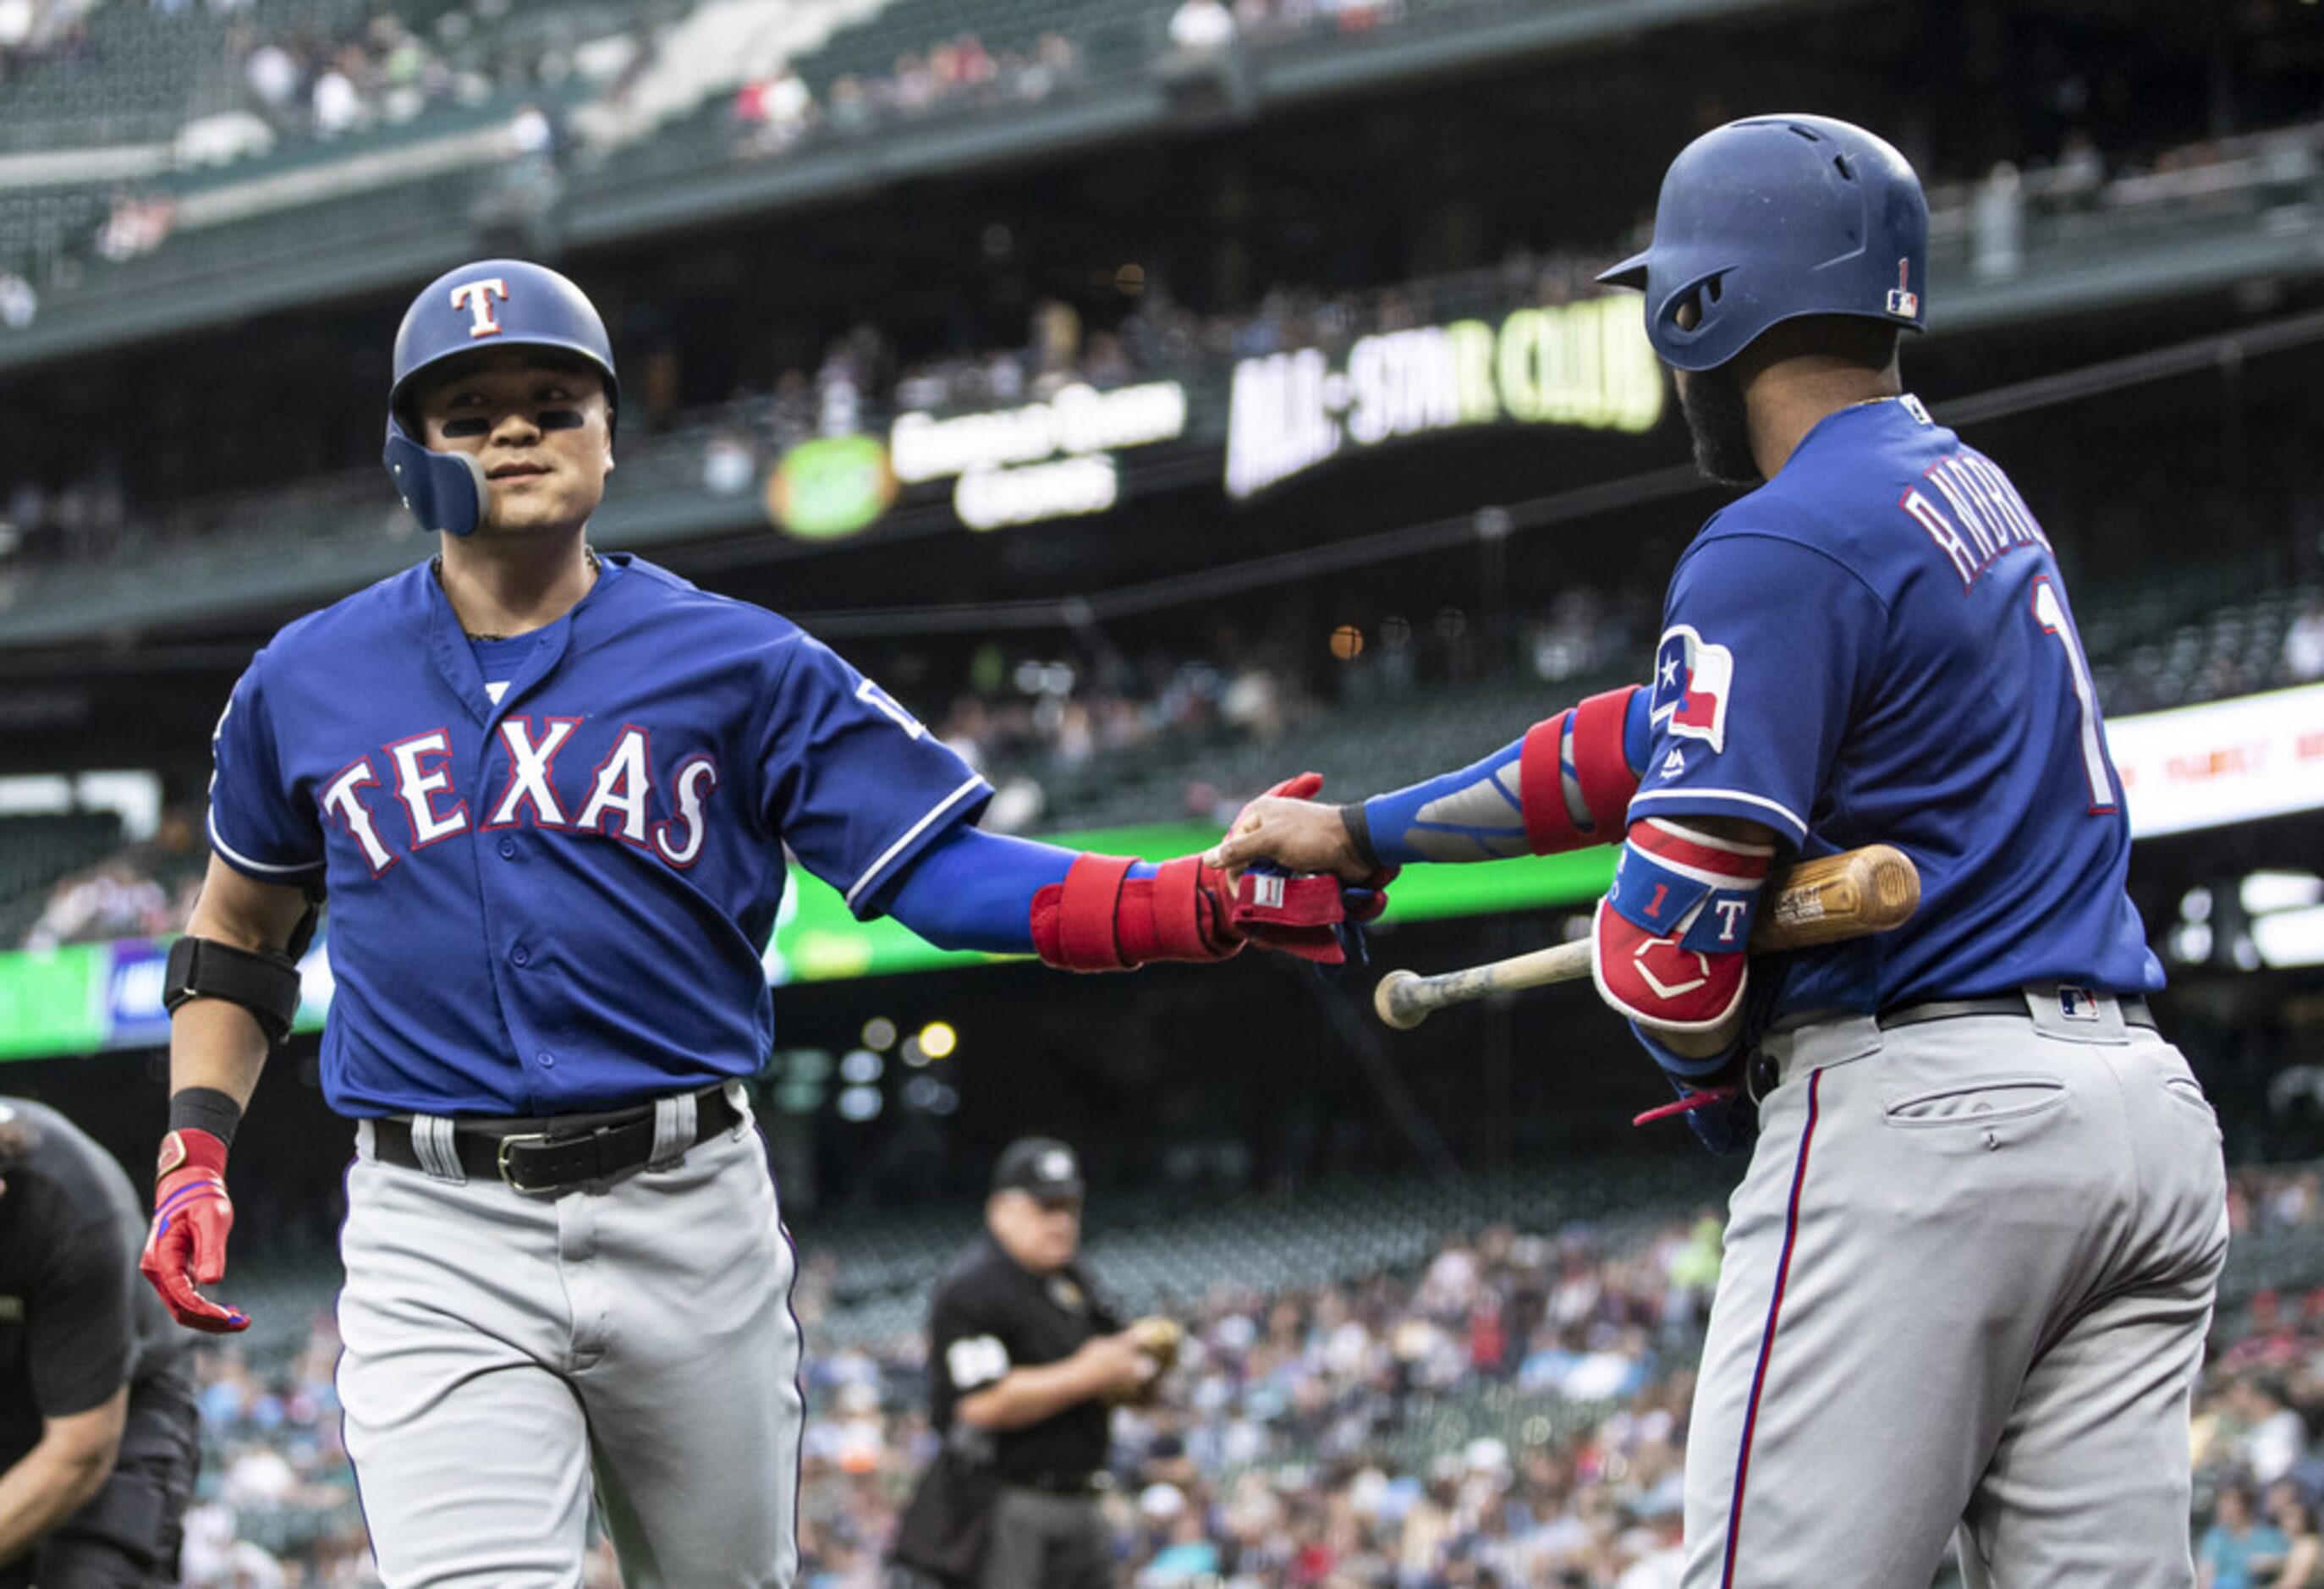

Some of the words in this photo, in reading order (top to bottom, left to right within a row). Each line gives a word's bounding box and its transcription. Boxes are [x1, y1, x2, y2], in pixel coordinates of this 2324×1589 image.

[450, 278, 509, 339] T
[2030, 575, 2119, 815] 1
[319, 714, 719, 880] TEXAS
[1642, 883, 1669, 918] 1
[1715, 899, 1747, 945] T
